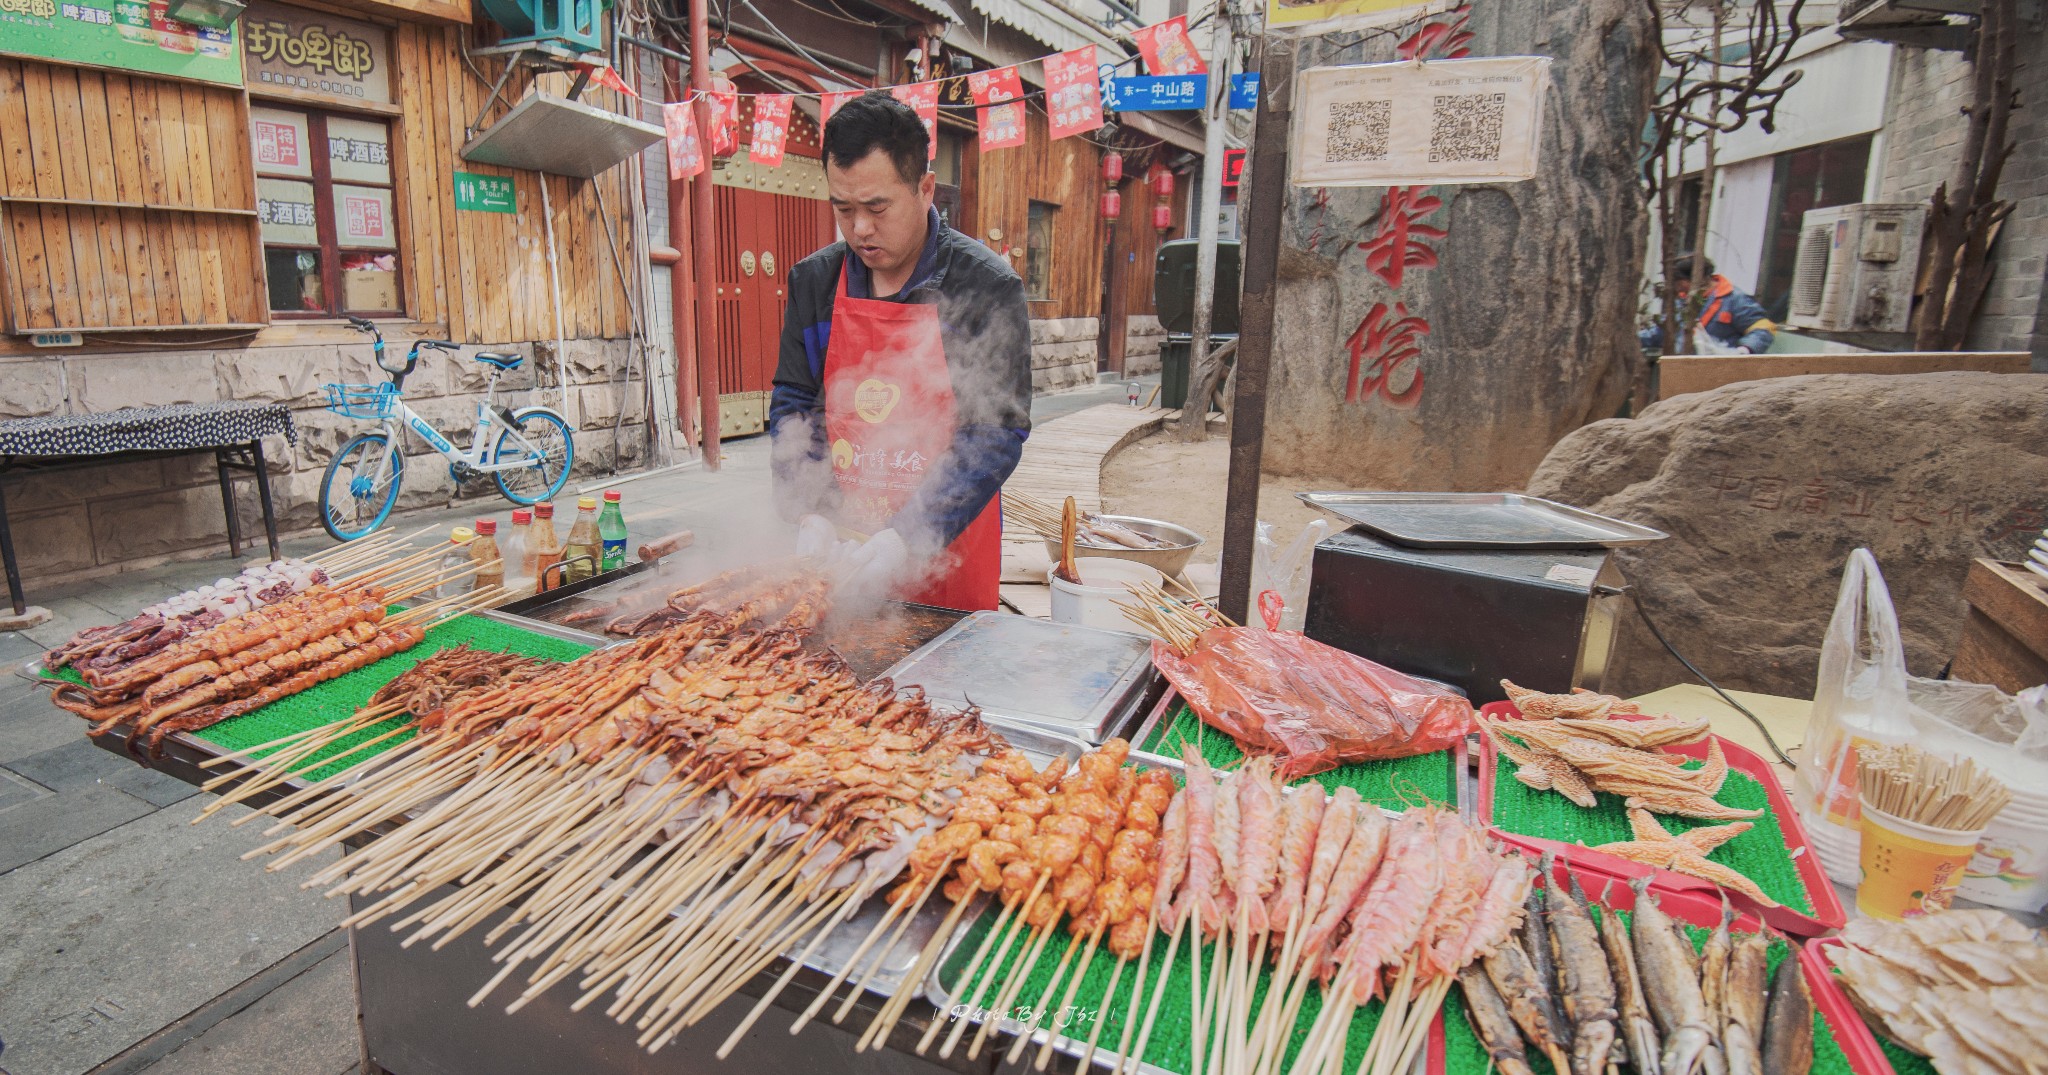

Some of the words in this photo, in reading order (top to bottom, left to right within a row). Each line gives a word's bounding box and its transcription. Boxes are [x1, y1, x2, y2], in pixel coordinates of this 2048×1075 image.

[62, 3, 113, 26] 啤酒酥
[246, 20, 374, 81] 玩啤郎
[1124, 86, 1134, 96] 东
[1151, 81, 1196, 98] 中山路
[328, 137, 388, 165] 啤酒酥
[479, 179, 510, 193] 洗手间
[602, 548, 623, 560] Sprite
